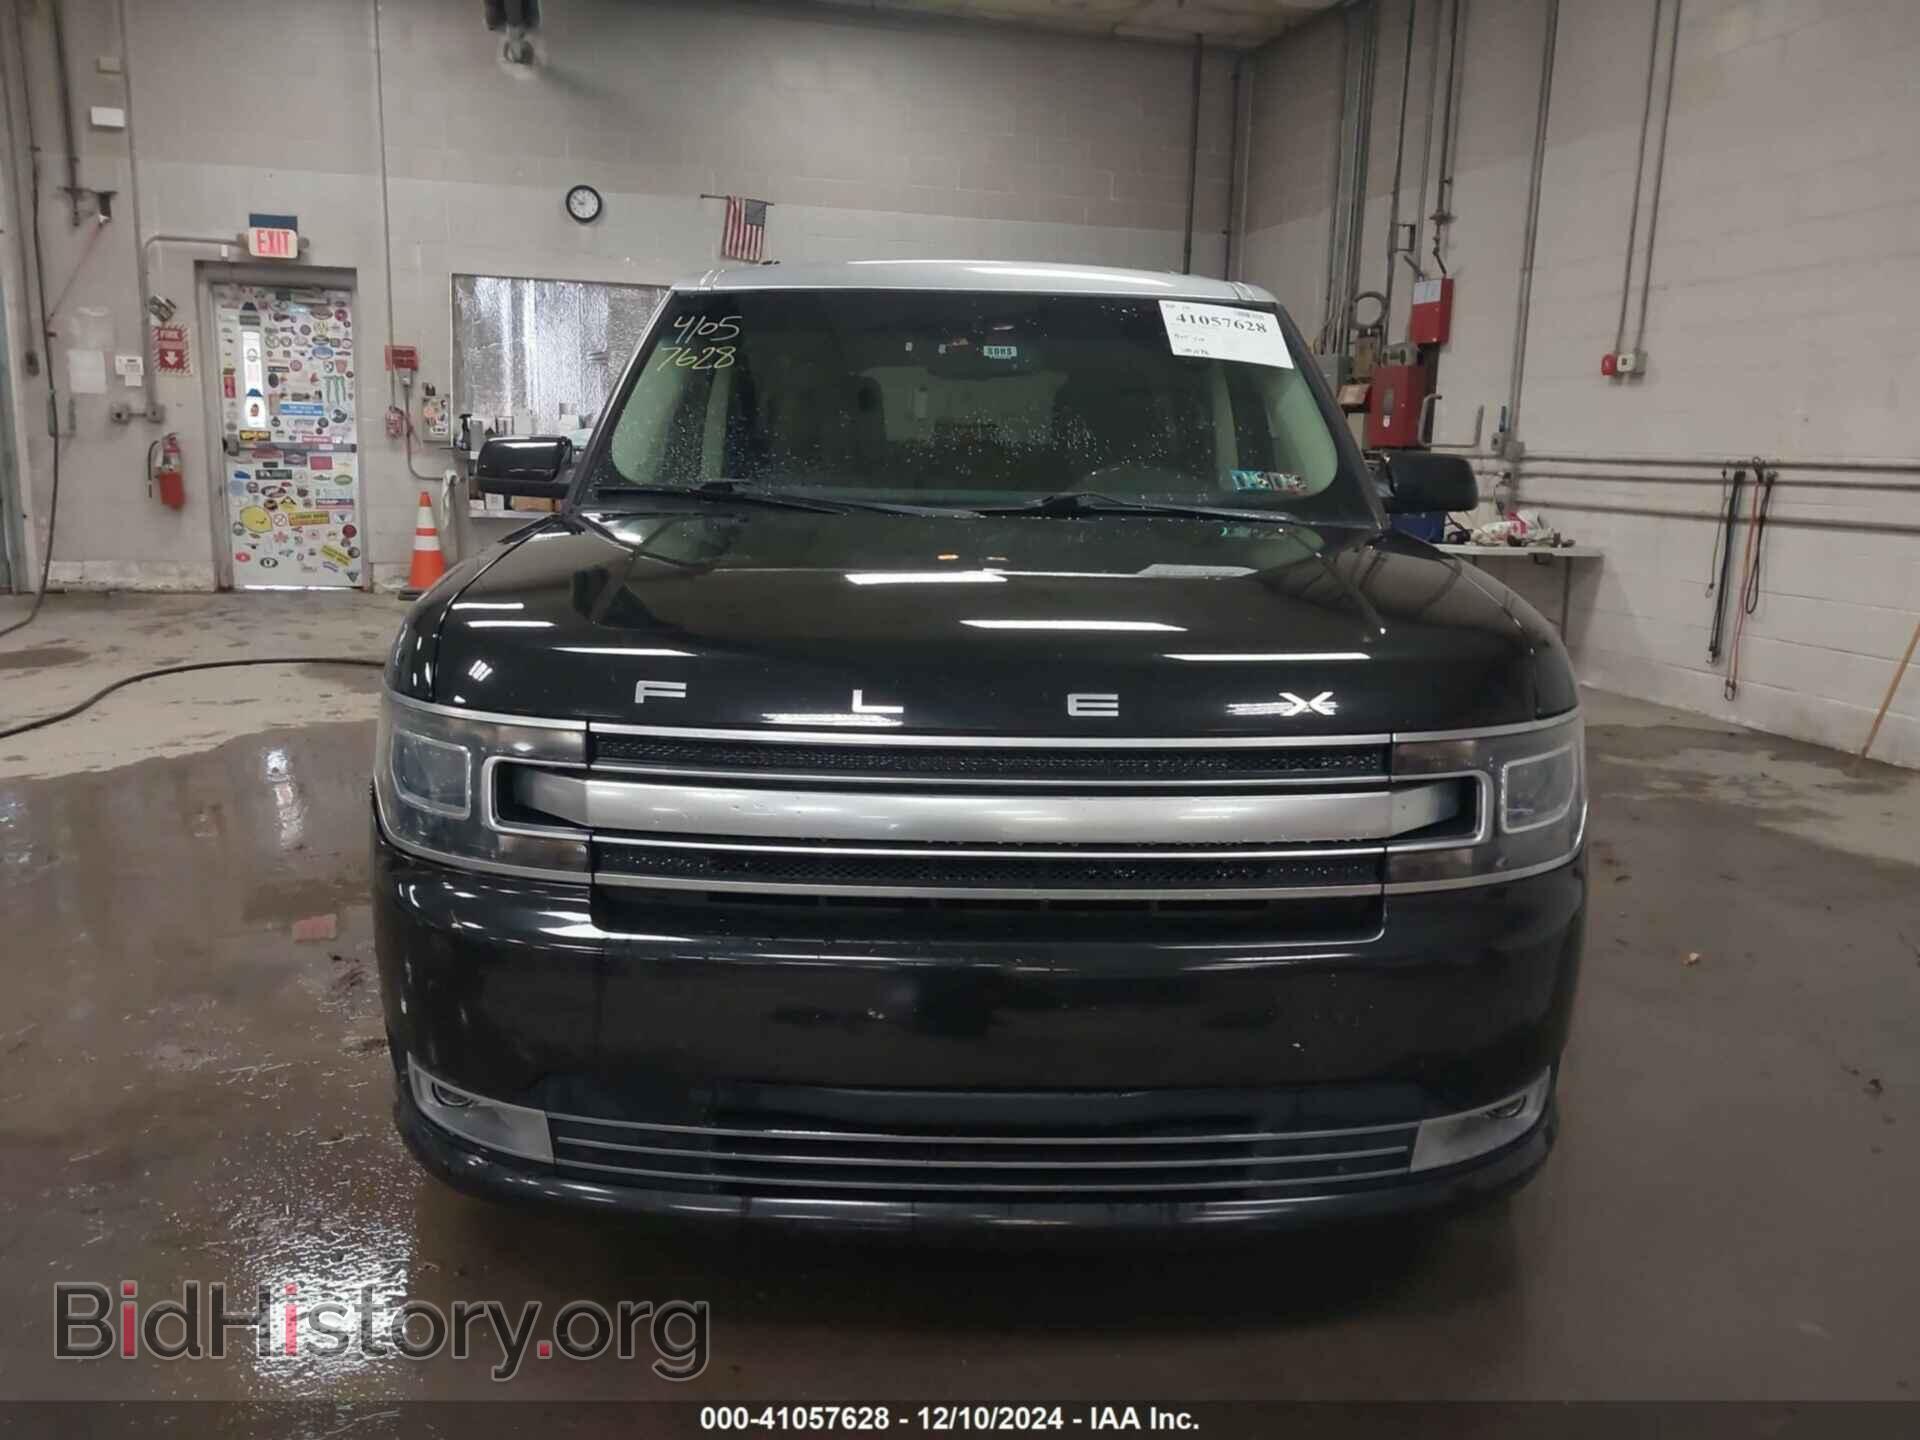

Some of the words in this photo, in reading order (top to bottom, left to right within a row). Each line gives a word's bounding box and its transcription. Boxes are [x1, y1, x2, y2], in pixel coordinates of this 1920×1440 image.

[255, 229, 289, 256] EXIT
[673, 315, 743, 344] 4105
[1176, 312, 1268, 334] 41057628
[657, 345, 737, 371] 7628
